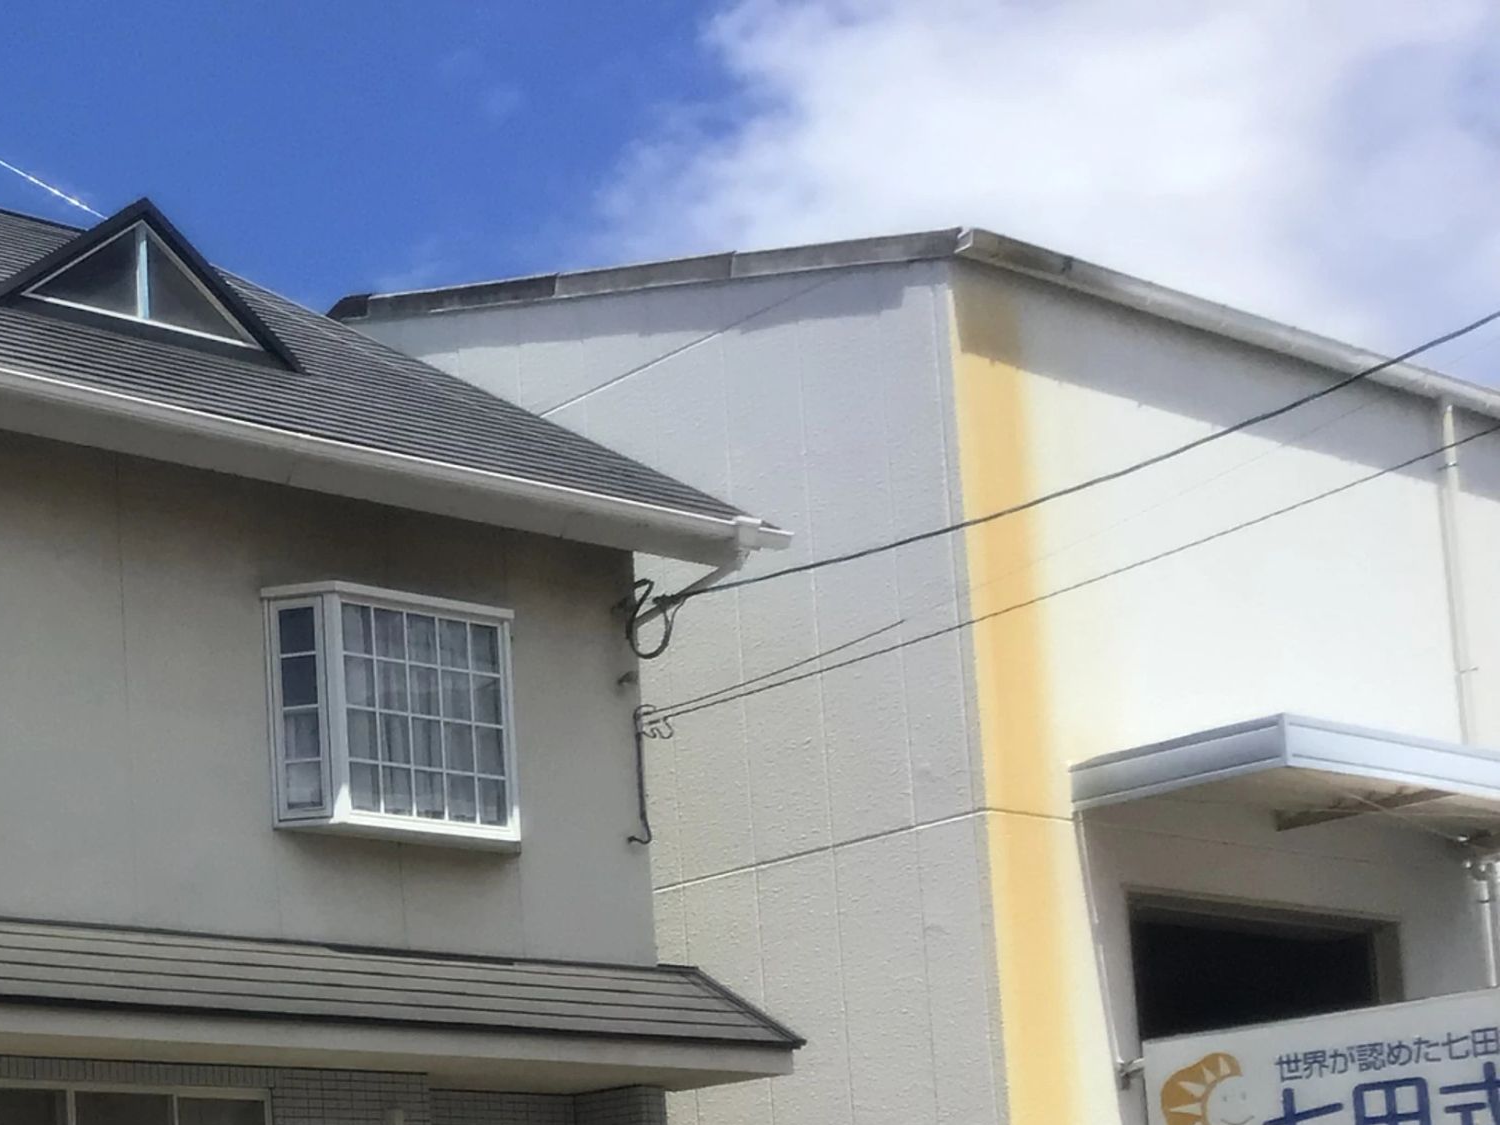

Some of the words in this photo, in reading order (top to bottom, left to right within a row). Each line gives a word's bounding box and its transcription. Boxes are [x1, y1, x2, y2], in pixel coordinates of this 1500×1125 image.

[1275, 1027, 1500, 1082] 世界が認めた七田
